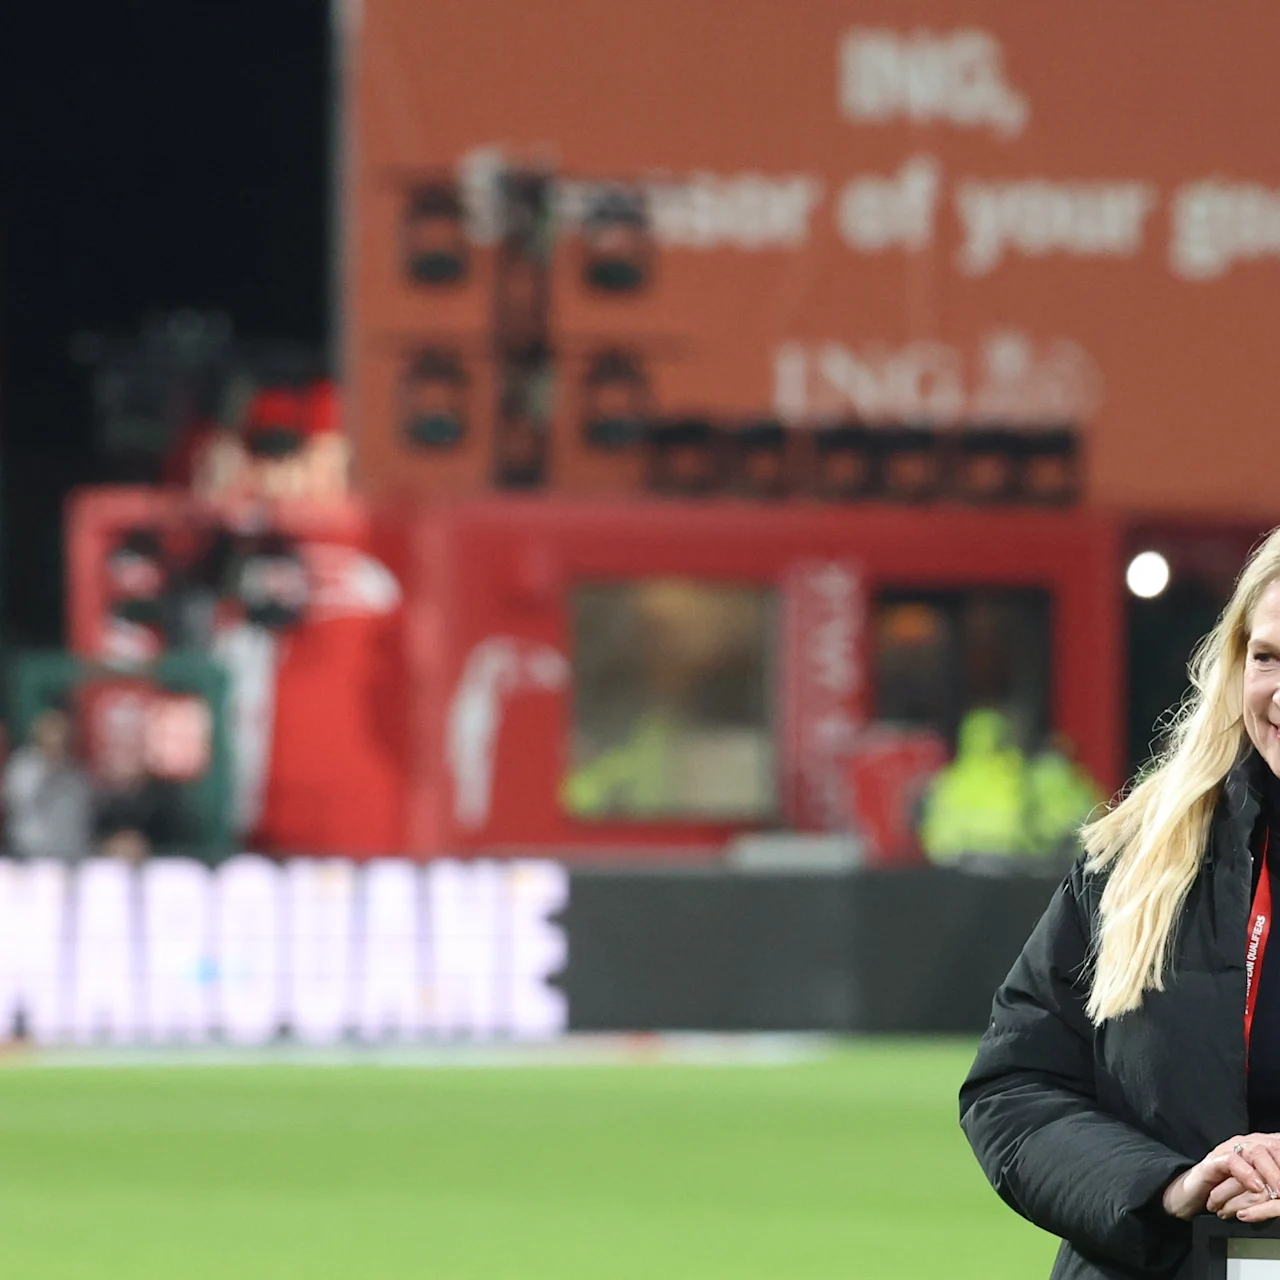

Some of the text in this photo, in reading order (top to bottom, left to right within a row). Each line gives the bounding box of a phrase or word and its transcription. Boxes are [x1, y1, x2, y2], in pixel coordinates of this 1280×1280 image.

[840, 157, 938, 250] of
[955, 178, 1158, 273] your
[1247, 915, 1266, 961] QUALIFIERS
